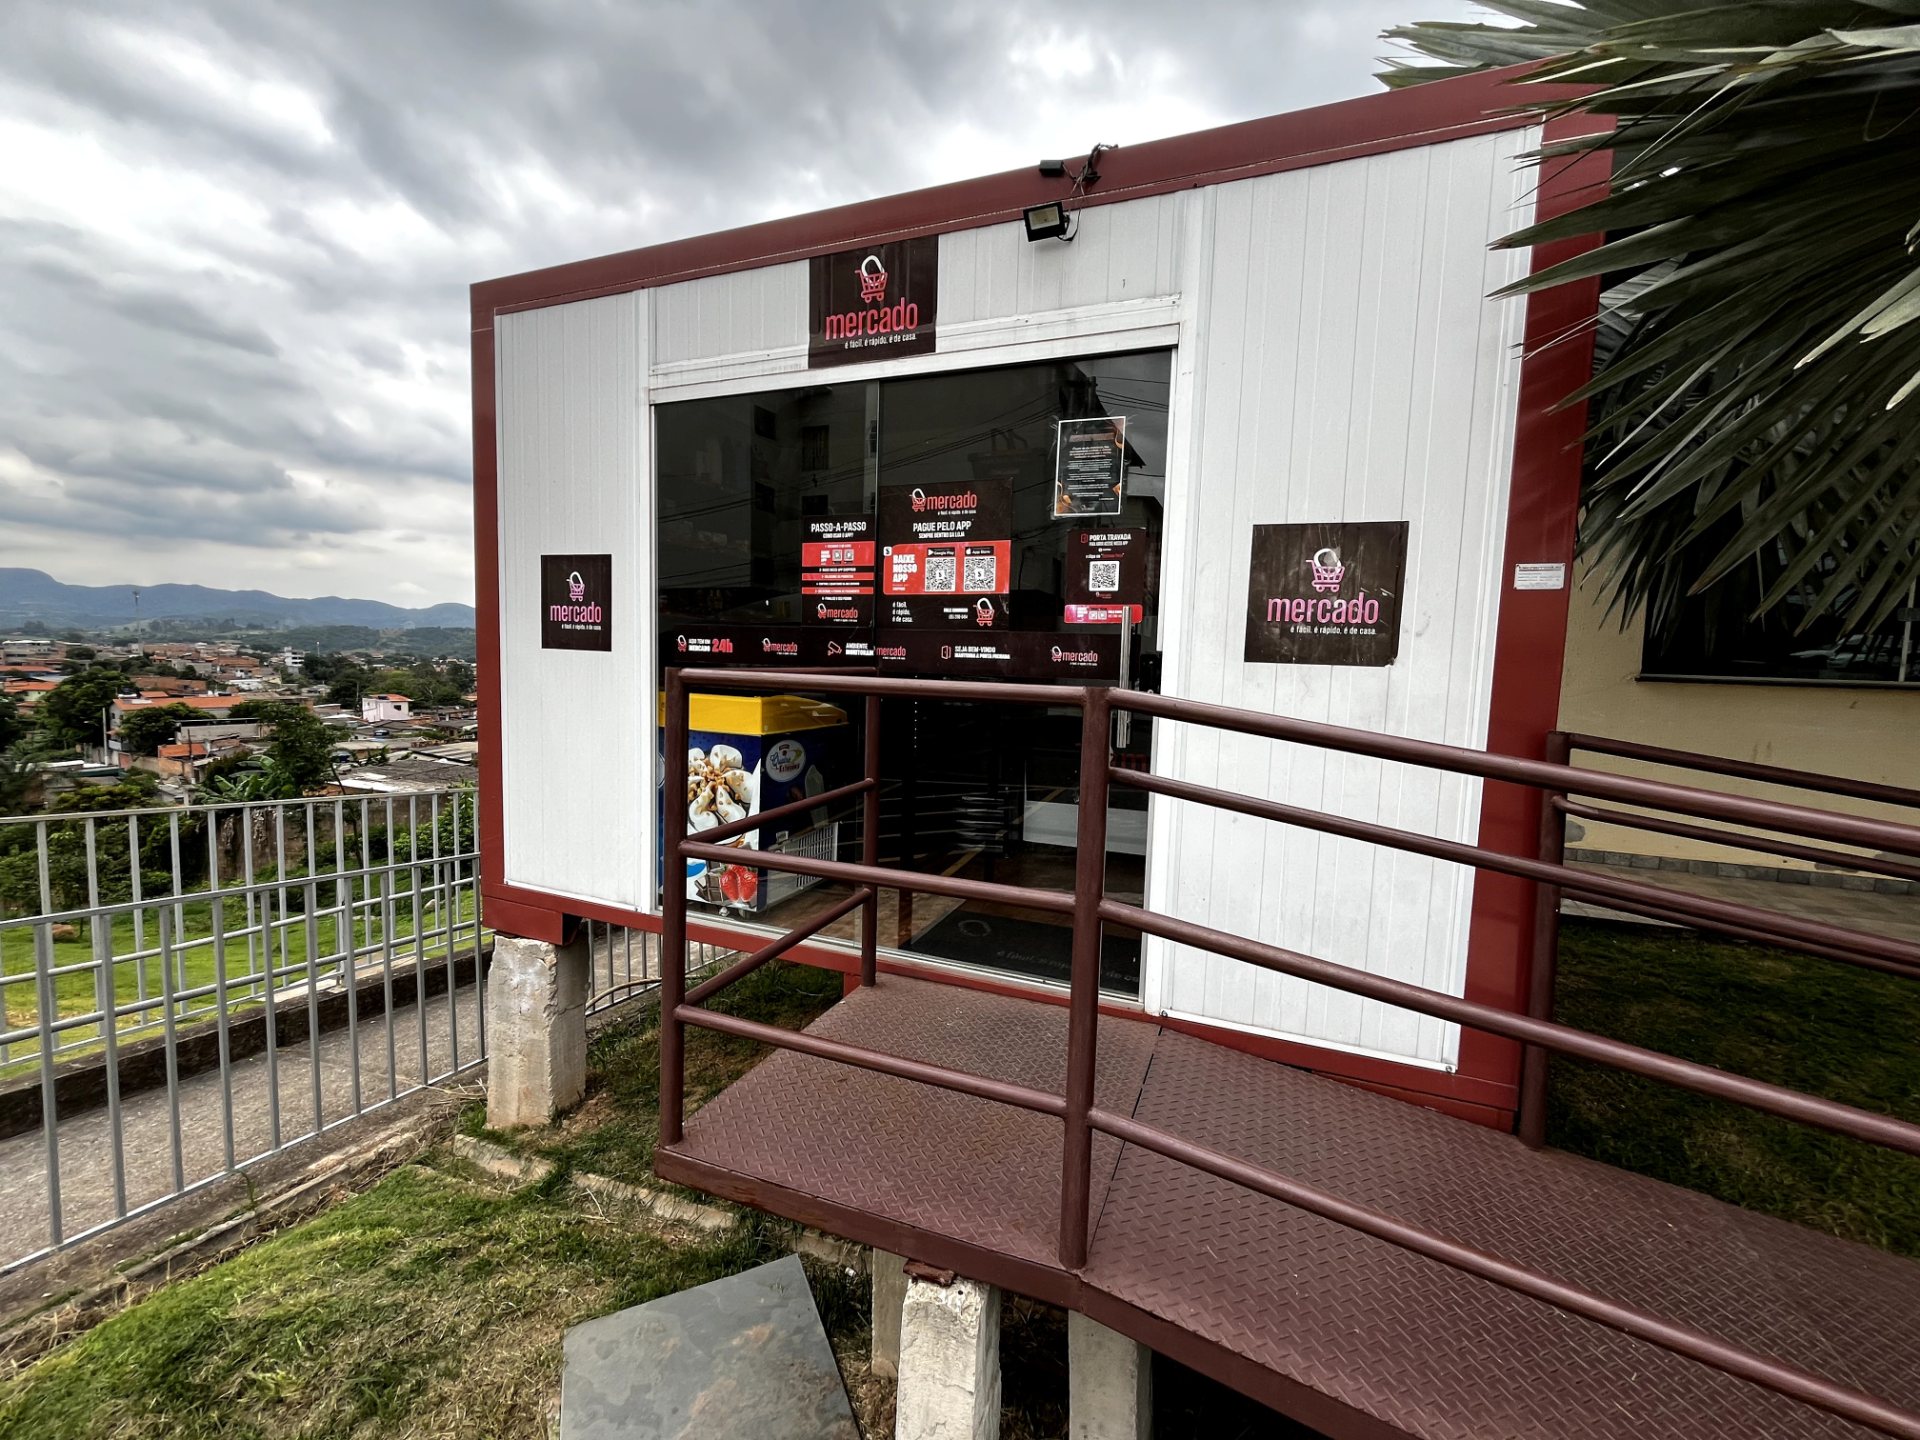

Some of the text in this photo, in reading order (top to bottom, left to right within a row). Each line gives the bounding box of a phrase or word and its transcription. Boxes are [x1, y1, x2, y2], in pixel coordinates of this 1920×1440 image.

[825, 297, 918, 340] mercado
[927, 490, 977, 510] mercado
[811, 522, 867, 532] PASSO-A-PASSO
[913, 520, 972, 532] PAGUE PELO APP
[892, 554, 915, 564] BAIXE
[892, 564, 918, 573] NOSSO
[892, 573, 909, 583] APP
[550, 601, 602, 623] mercado
[827, 607, 858, 619] mercado
[1267, 592, 1380, 624] mercado
[1349, 626, 1358, 635] de
[712, 638, 733, 653] 24h
[770, 641, 798, 652] mercado
[876, 646, 906, 656] mercado
[1062, 650, 1098, 663] mercado
